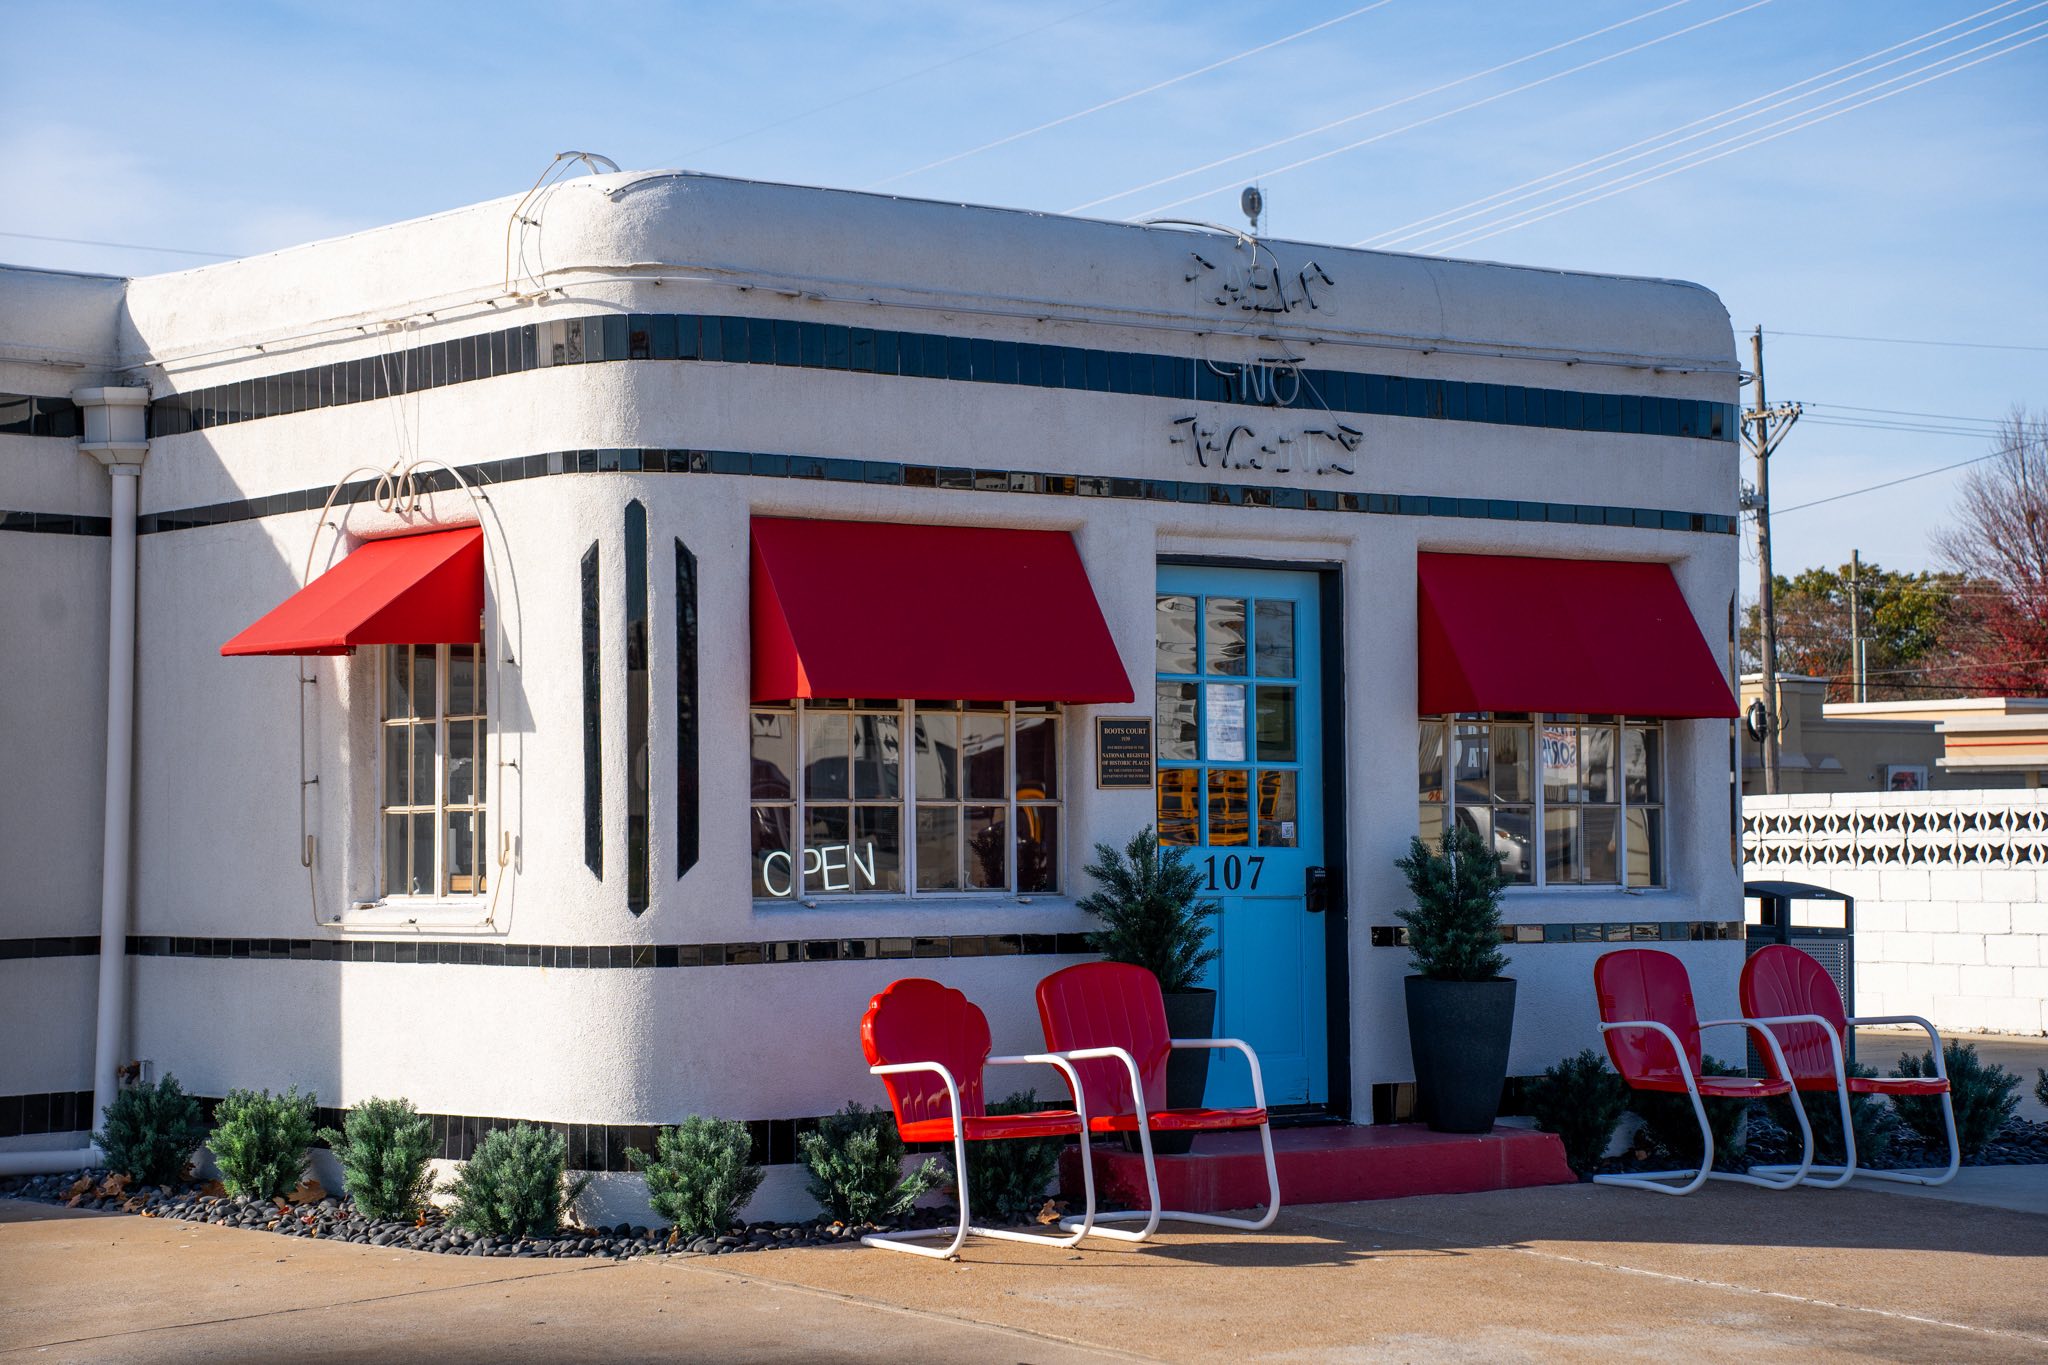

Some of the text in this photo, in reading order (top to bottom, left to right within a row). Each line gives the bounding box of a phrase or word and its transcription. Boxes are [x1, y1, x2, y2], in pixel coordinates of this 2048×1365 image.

[1241, 358, 1300, 406] NO
[1104, 727, 1147, 735] BOOTS COURT
[763, 842, 876, 897] OPEN
[1204, 854, 1265, 891] 107
